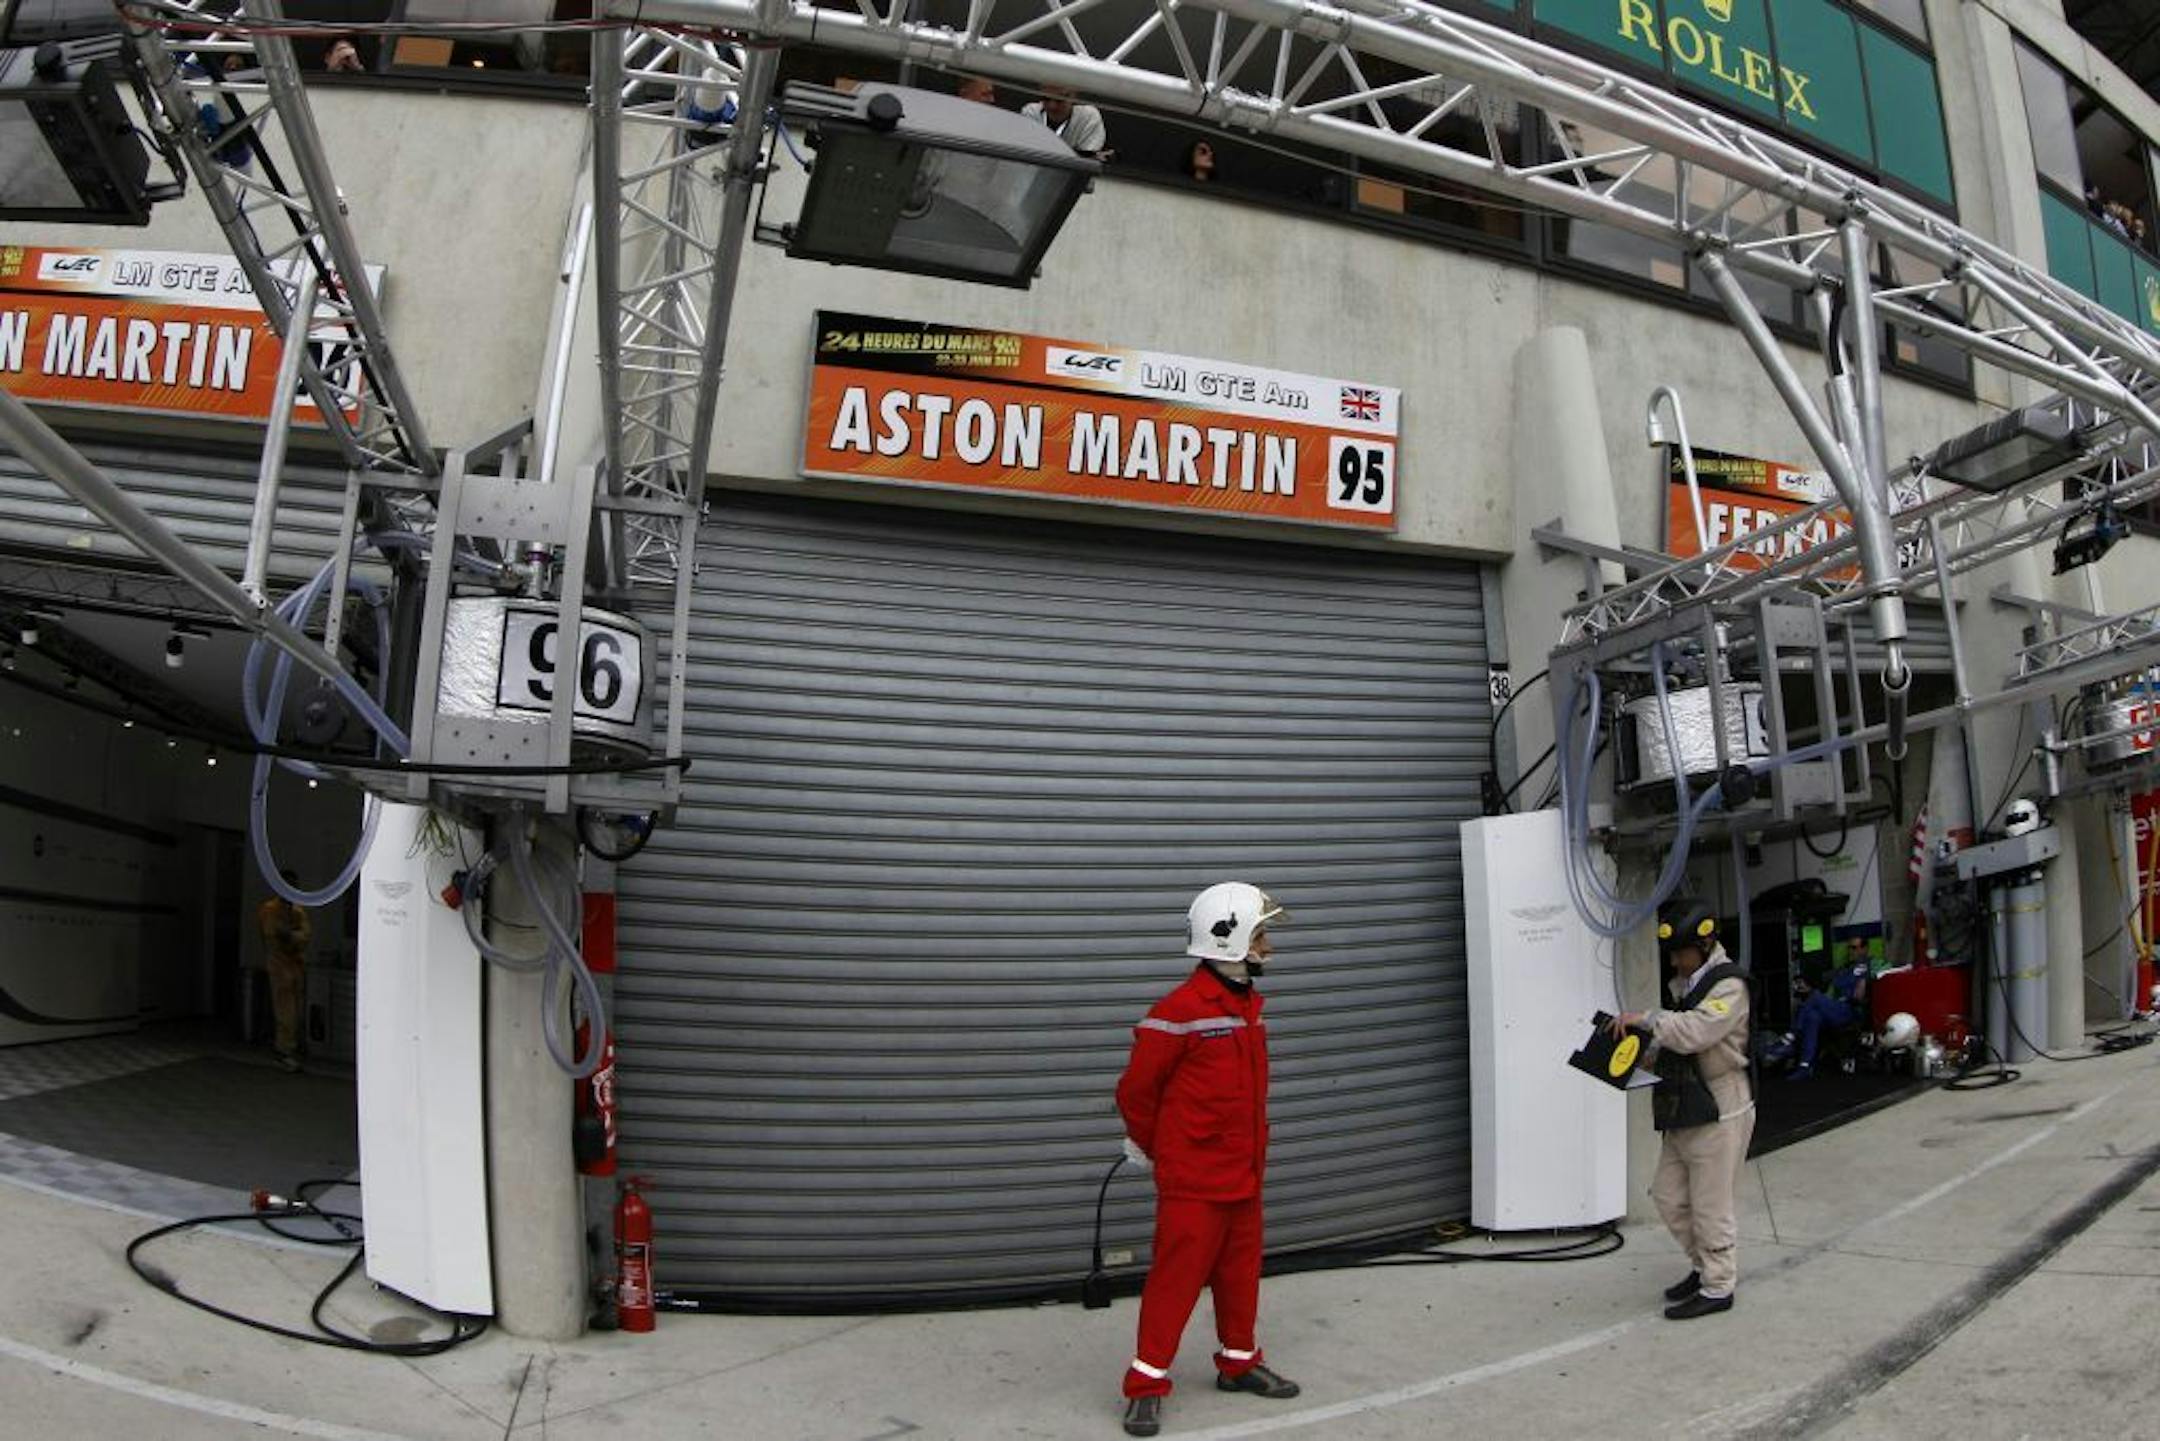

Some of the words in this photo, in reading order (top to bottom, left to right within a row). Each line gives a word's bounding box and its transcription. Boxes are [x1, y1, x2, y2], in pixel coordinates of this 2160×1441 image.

[1618, 0, 1816, 119] ROLEX
[112, 262, 151, 286] LM
[160, 264, 217, 291] GTE
[43, 313, 253, 392] MARTIN
[863, 332, 920, 350] HEURES
[920, 334, 946, 350] DU
[946, 334, 993, 352] MANS
[1141, 362, 1186, 392] LM
[1195, 371, 1256, 402] GTE
[1262, 382, 1309, 410] Am
[829, 386, 1043, 470] ASTON
[1067, 410, 1298, 497] MARTIN
[1338, 444, 1385, 506] 95
[527, 621, 622, 709] 96
[1491, 676, 1510, 699] 38
